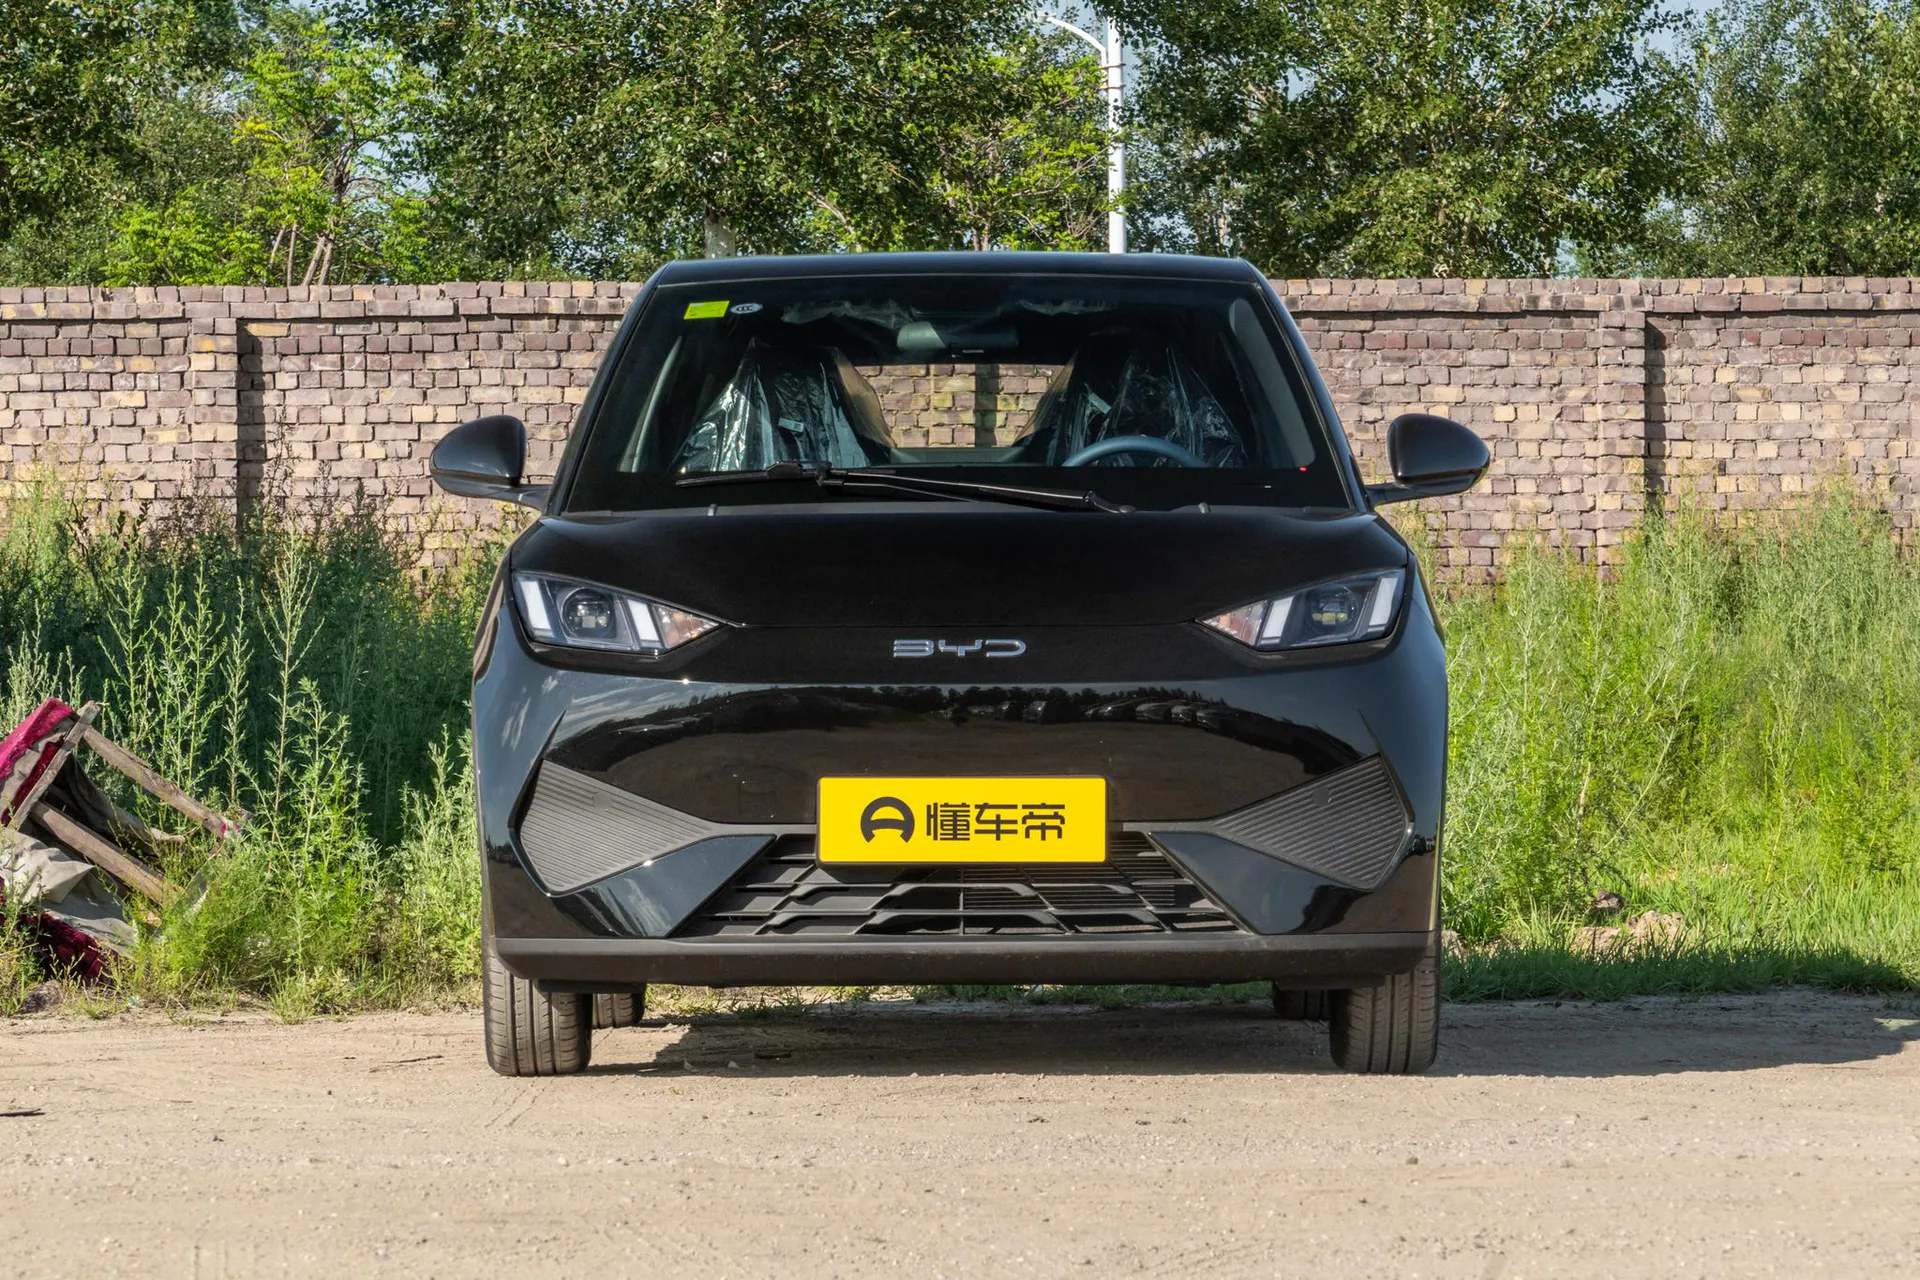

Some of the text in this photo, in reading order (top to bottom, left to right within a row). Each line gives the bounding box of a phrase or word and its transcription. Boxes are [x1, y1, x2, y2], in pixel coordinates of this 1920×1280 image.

[893, 638, 1027, 657] BYD
[926, 802, 1066, 841] 懂车帝
